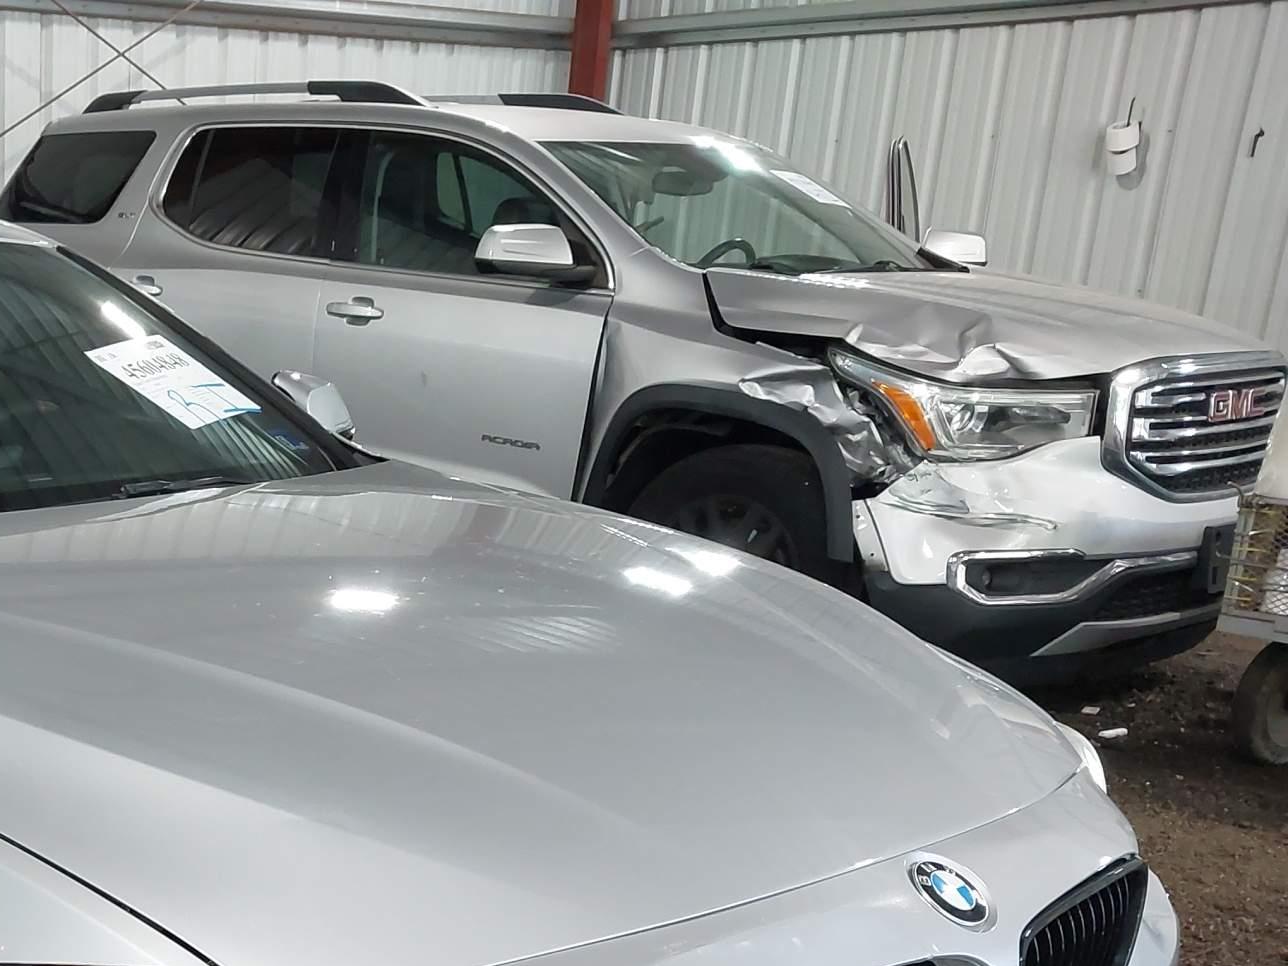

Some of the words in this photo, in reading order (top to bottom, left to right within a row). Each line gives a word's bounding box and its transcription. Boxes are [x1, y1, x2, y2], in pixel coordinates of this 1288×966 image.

[120, 352, 190, 380] 45604848
[1208, 388, 1265, 423] GMC
[480, 434, 542, 451] ACADIA
